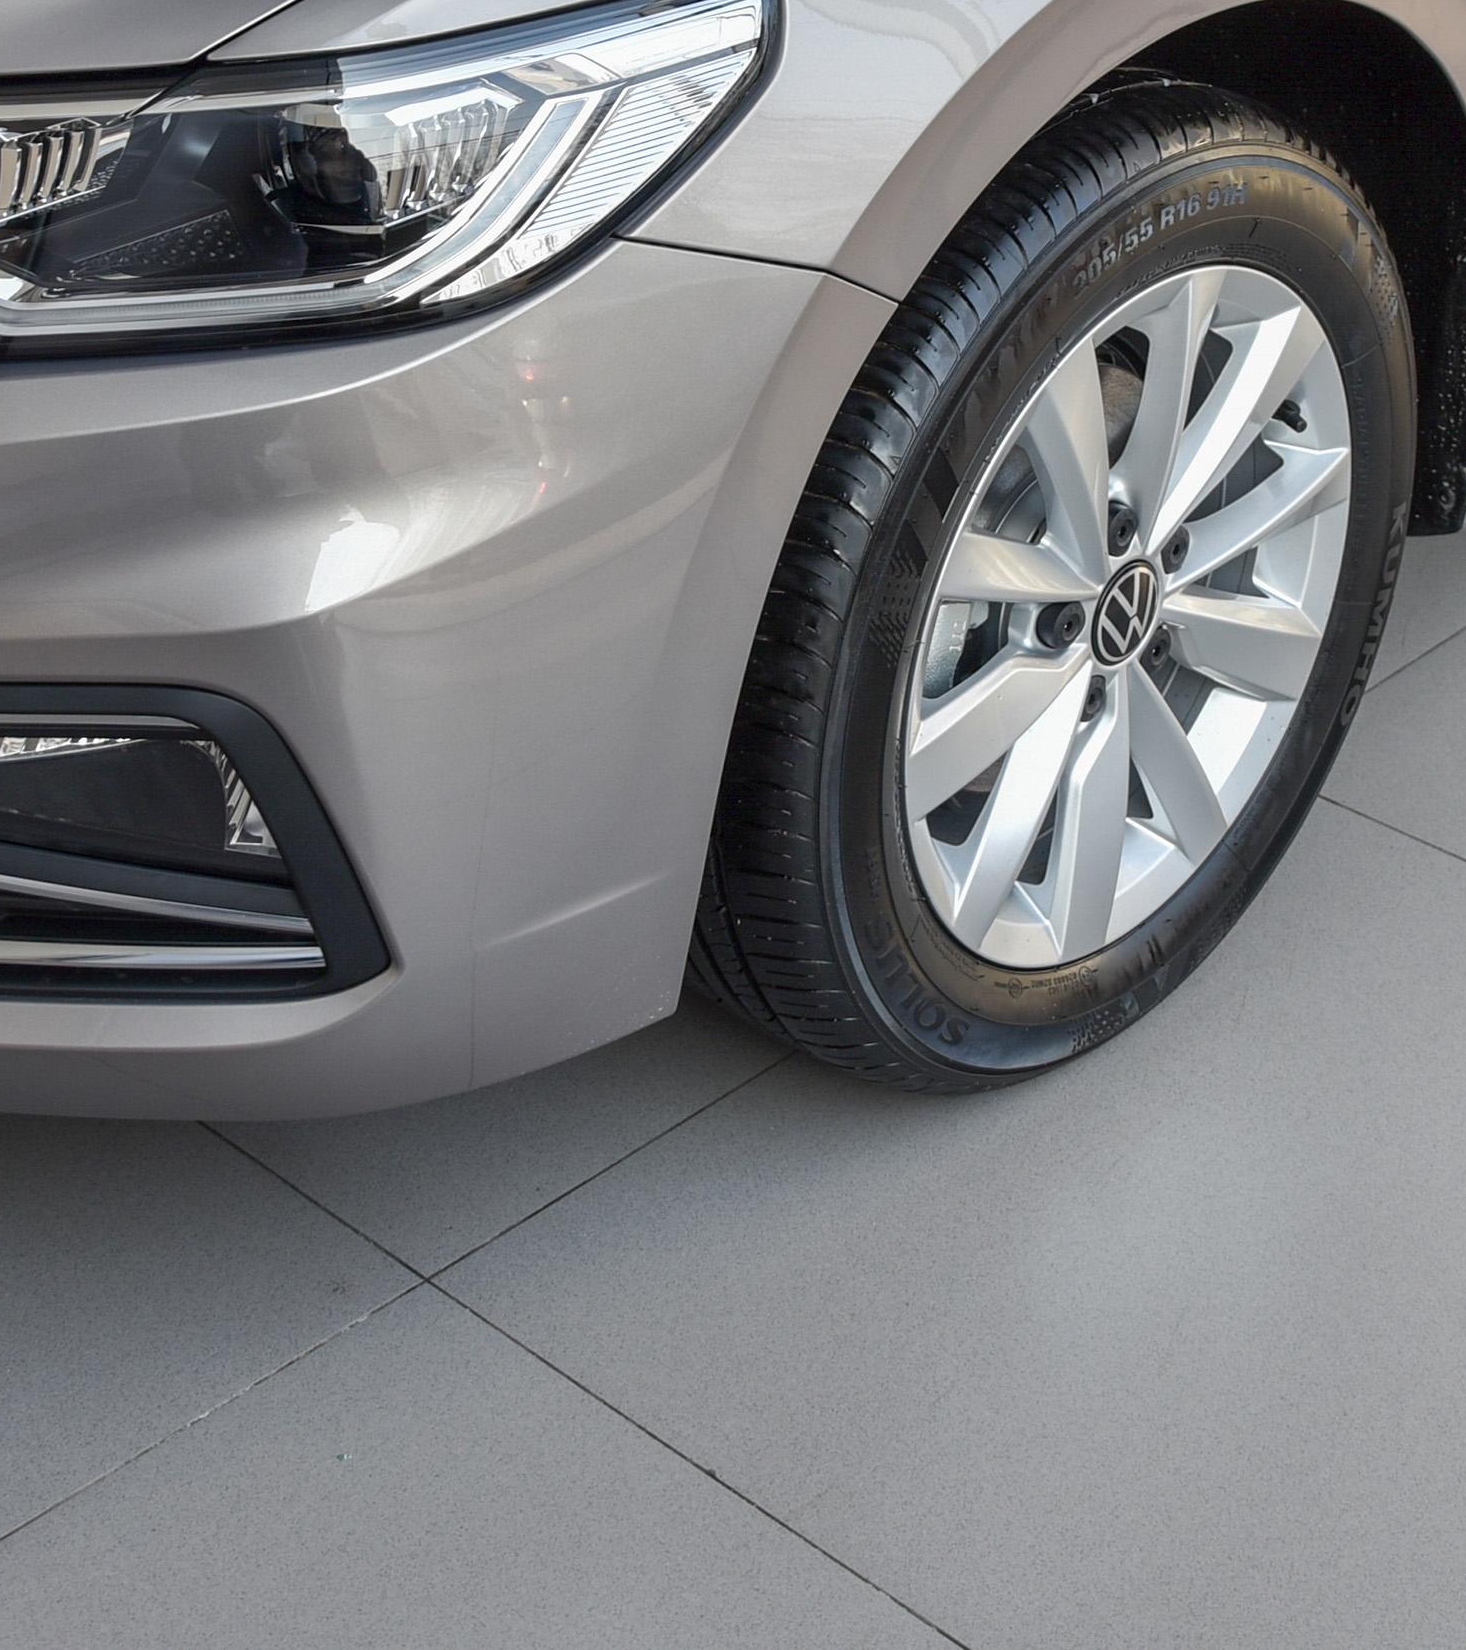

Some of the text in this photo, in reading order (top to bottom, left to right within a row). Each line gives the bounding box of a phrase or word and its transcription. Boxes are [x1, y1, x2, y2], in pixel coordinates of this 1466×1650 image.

[1074, 216, 1155, 293] 205/55
[1159, 193, 1202, 231] R16
[1339, 500, 1407, 728] KUMHO
